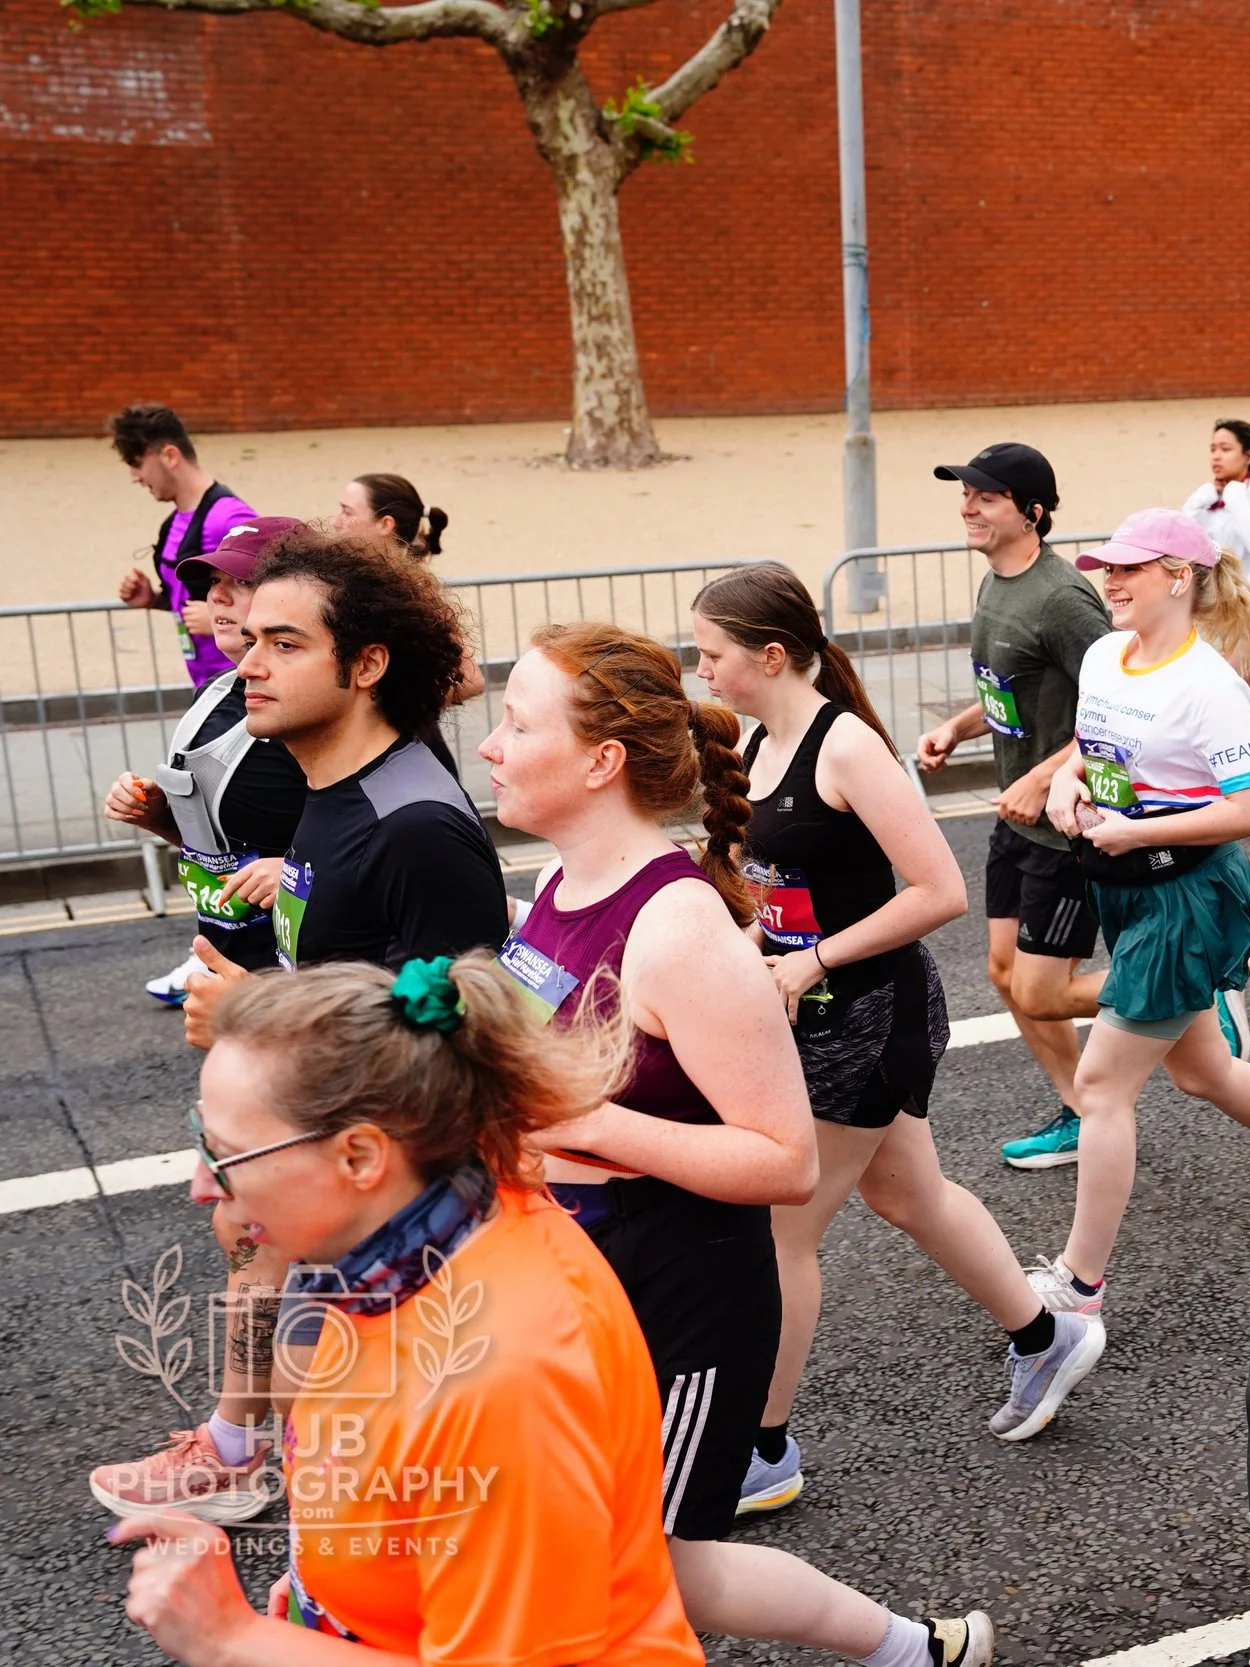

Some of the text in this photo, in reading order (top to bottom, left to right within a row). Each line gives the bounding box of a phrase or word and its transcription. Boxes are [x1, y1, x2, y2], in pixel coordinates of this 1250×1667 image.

[1080, 707, 1107, 723] cymru
[1121, 704, 1157, 722] canser
[1090, 773, 1119, 803] 1423
[517, 944, 553, 978] SWANSEA
